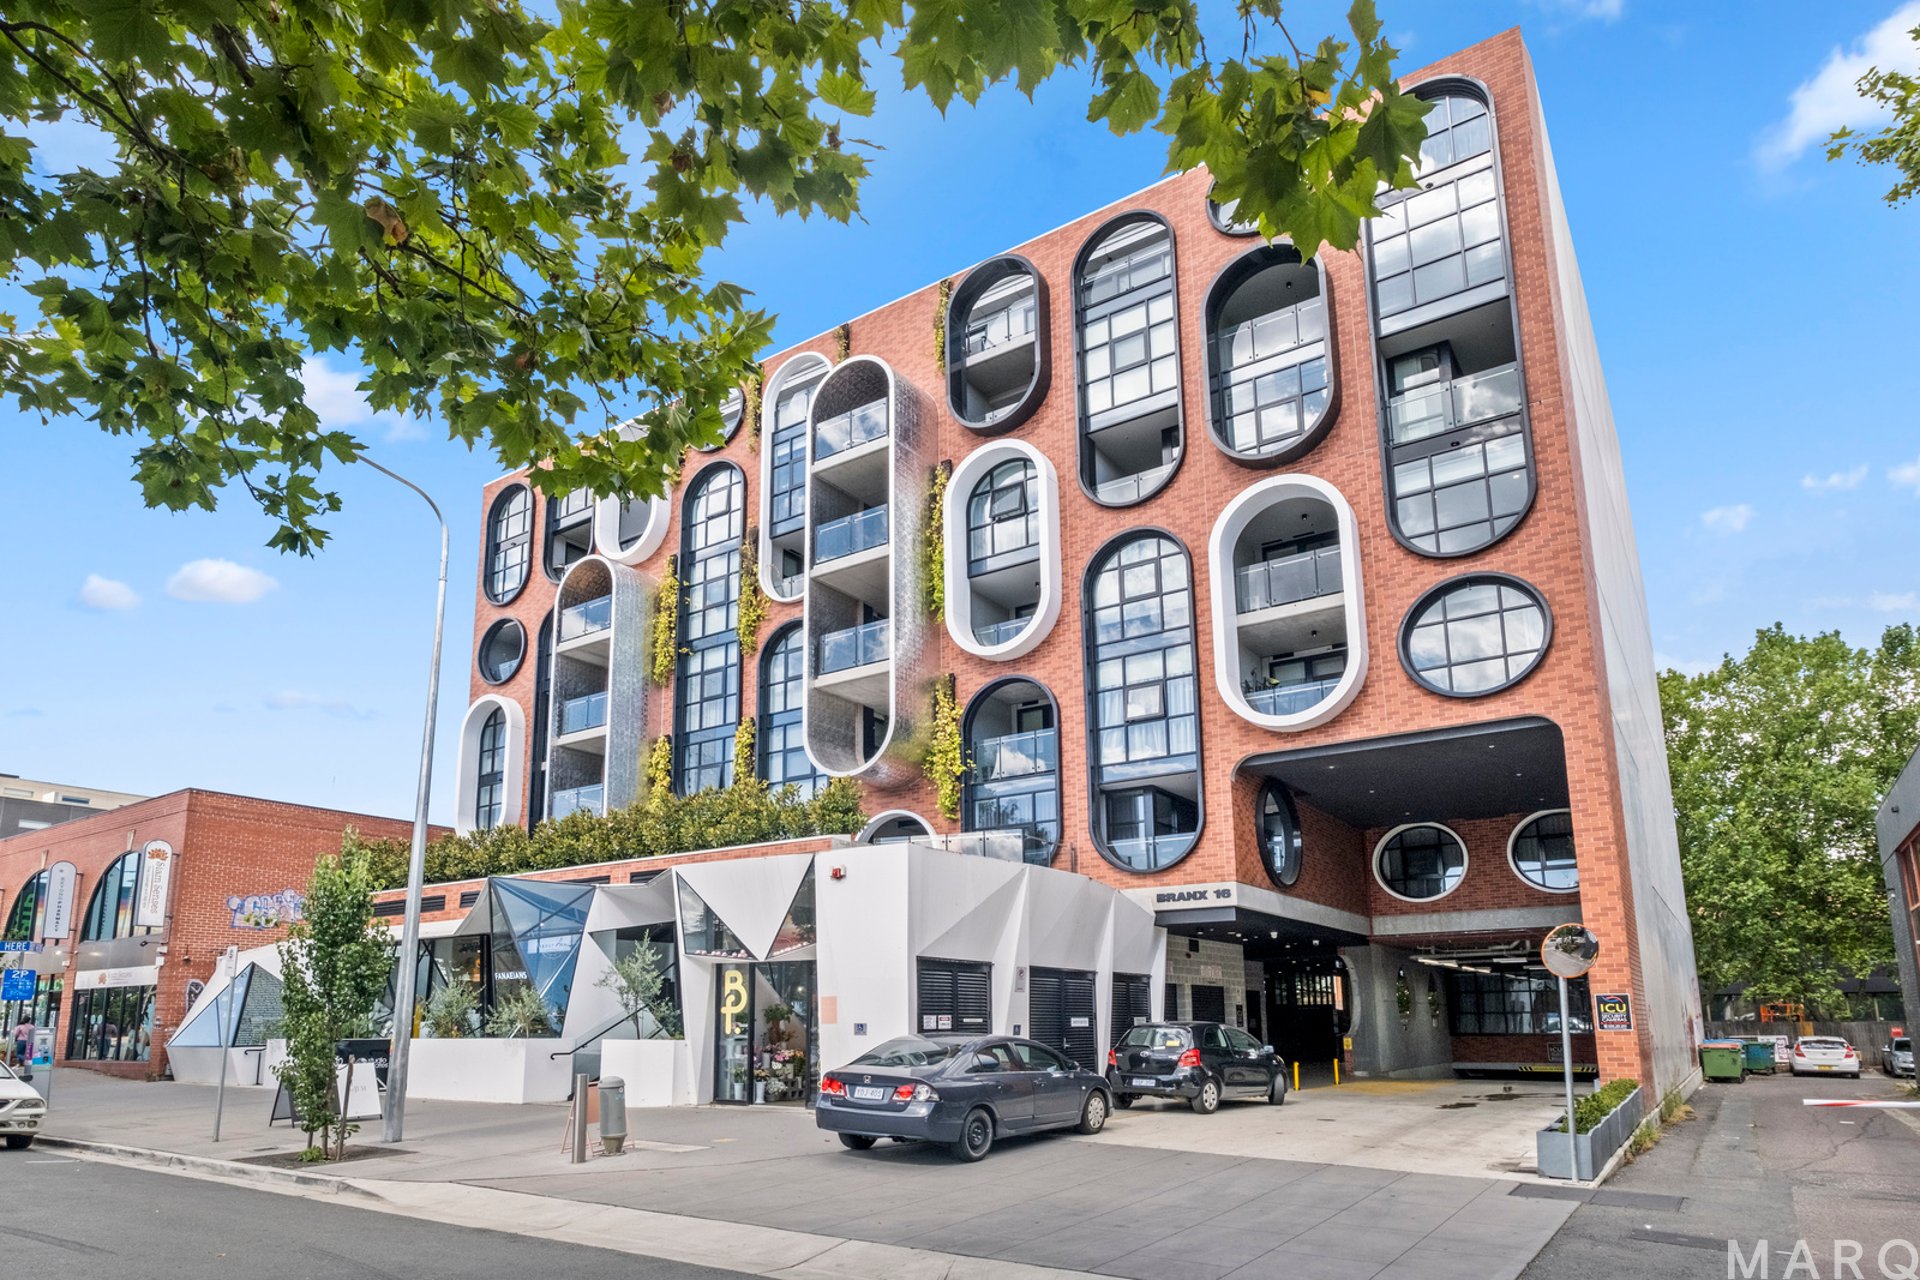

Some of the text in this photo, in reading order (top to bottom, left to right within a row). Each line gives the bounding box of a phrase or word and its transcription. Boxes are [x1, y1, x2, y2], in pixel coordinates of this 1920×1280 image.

[150, 861, 165, 914] Siam Senses
[1156, 889, 1231, 903] BRANX 16
[4, 942, 27, 951] HERE
[11, 970, 29, 979] 2P
[1600, 1003, 1627, 1013] ICU
